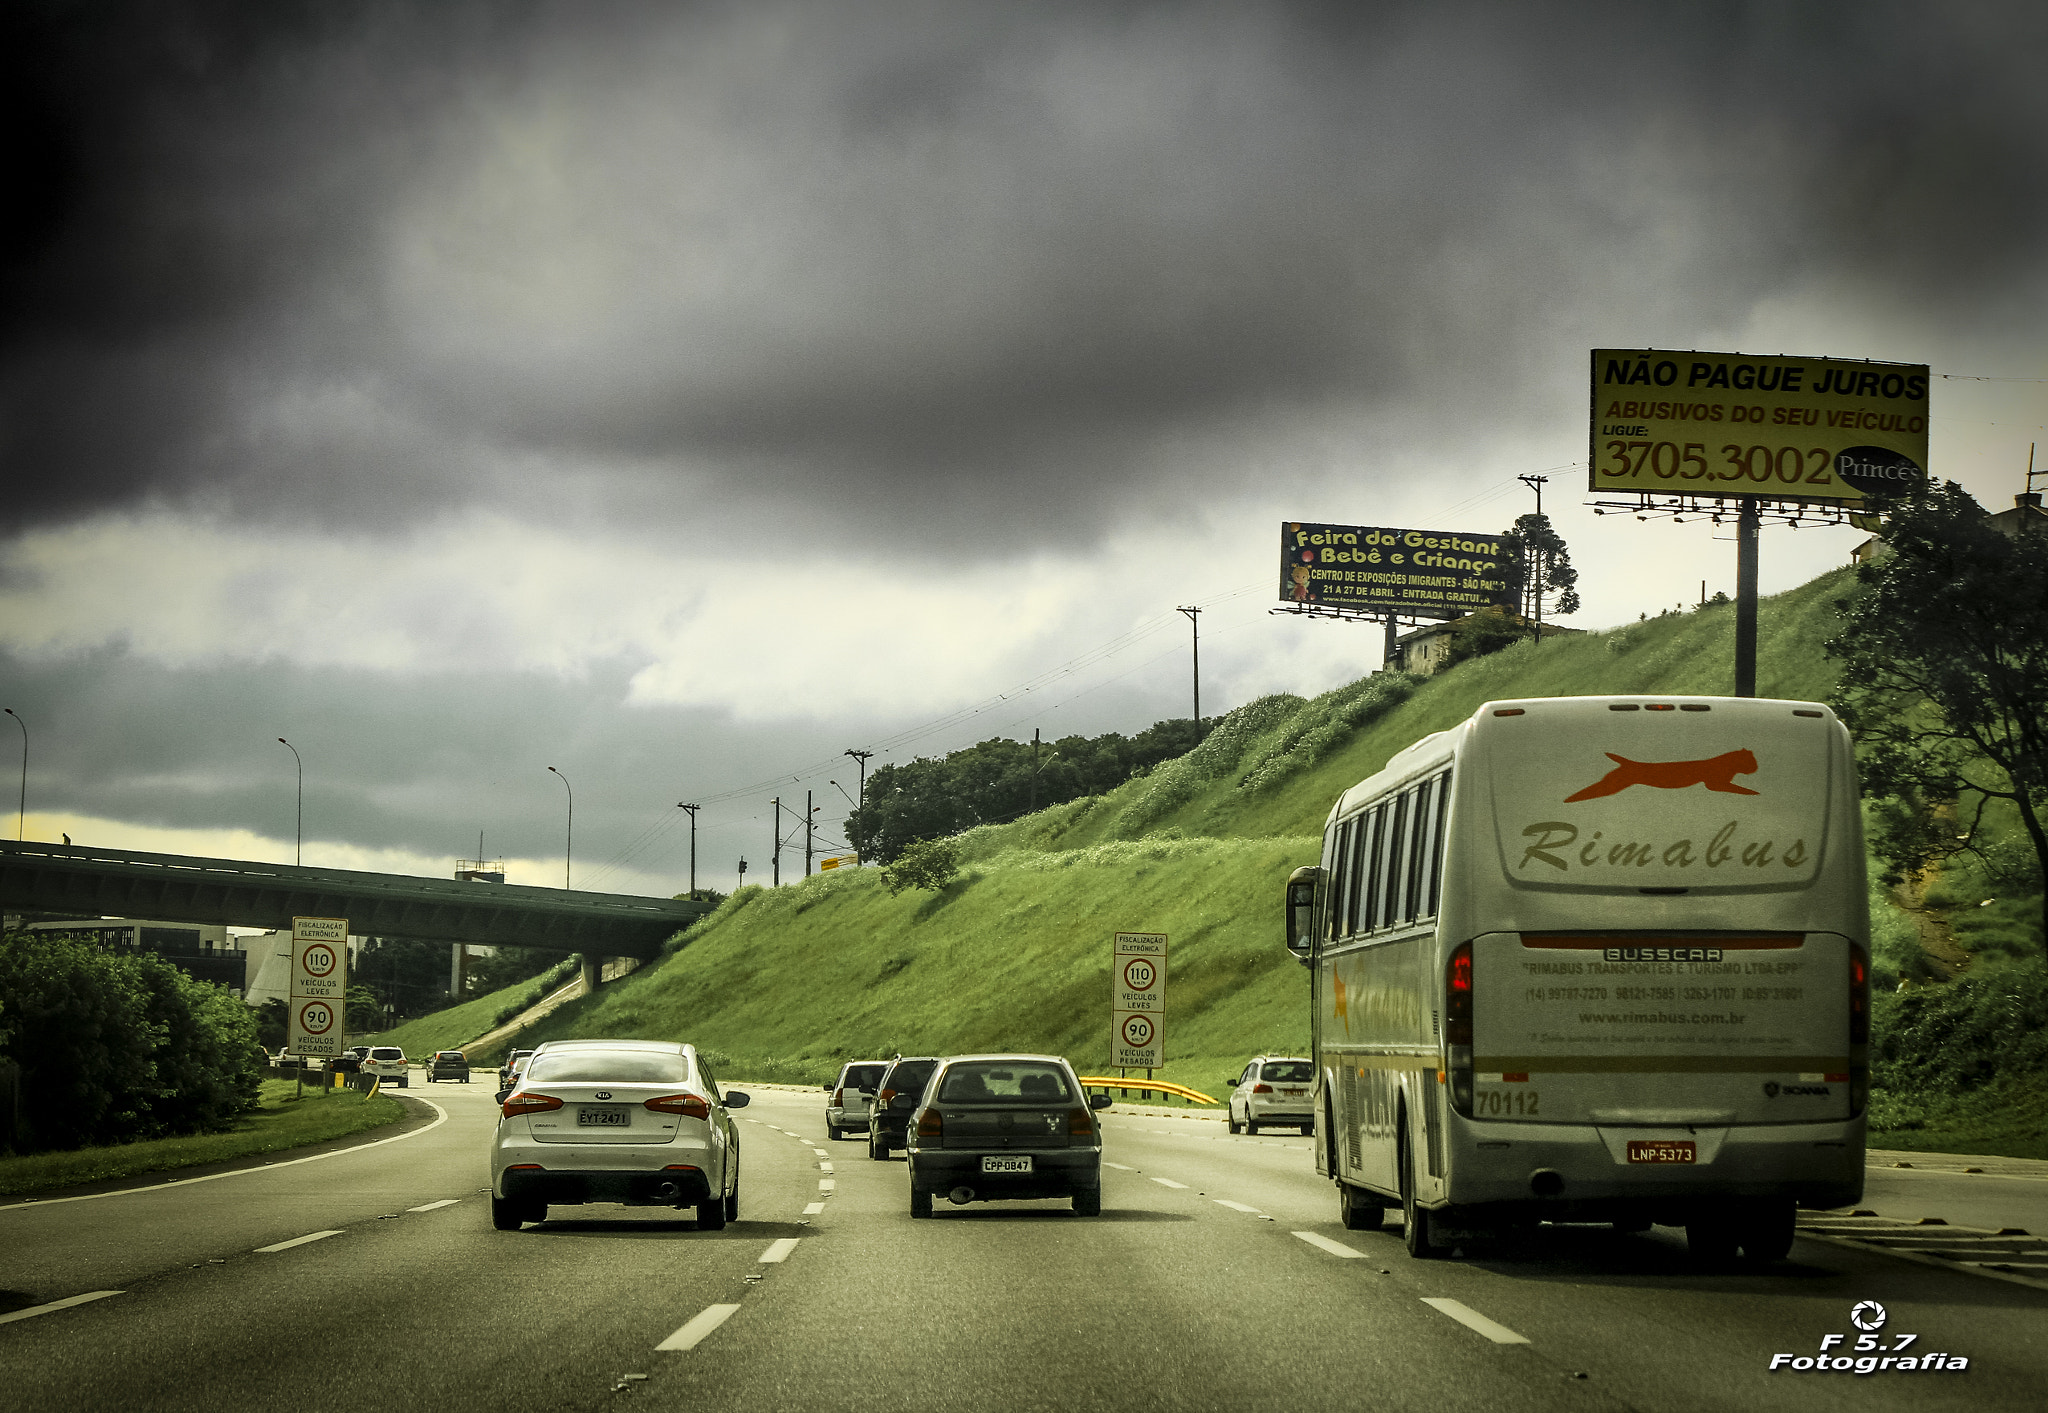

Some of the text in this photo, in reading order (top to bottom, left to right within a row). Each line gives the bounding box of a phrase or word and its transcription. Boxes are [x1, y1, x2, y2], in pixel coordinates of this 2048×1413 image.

[1603, 354, 1927, 400] NÃO PAGUE JUROS
[1605, 400, 1925, 434] ABUSIVOS DO SEU VEÍCULO
[1602, 424, 1649, 437] LIGUE:
[1601, 439, 1832, 485] 3705.3002
[1296, 529, 1501, 556] Feira da Gestant
[1320, 547, 1382, 564] Bebê
[1389, 552, 1405, 565] e
[1311, 568, 1343, 581] CENTRO
[1344, 571, 1356, 582] DE
[1357, 571, 1407, 586] EXPOSIÇÕES
[1408, 574, 1457, 588] IMIGRANTES
[1462, 576, 1479, 590] SÃO
[1322, 584, 1333, 594] 21
[1335, 585, 1342, 594] A
[1343, 585, 1355, 595] 27
[1356, 586, 1368, 596] DE
[1369, 587, 1396, 598] ABRIL
[1402, 588, 1444, 600] ENTRADA
[1518, 820, 1810, 872] Rimabus
[297, 921, 343, 930] FISCALIZAÇÃO
[300, 930, 340, 938] ELETRÔNICA
[1119, 936, 1163, 944] FISCALIZAÇÃO
[1121, 944, 1160, 952] ELETRÔNICA
[1606, 948, 1721, 961] BUSSCAR
[309, 953, 329, 967] 110
[1130, 967, 1150, 981] 110
[1586, 962, 1673, 975] TRANSPORTES
[1676, 962, 1684, 975] E
[1688, 962, 1741, 975] TURISMO
[300, 978, 337, 988] VEÍCULOS
[1121, 991, 1157, 1001] VEÍCULOS
[307, 1011, 327, 1024] 90
[1579, 1011, 1745, 1024] www.rimabus.com.br
[1129, 1024, 1148, 1037] 90
[297, 1035, 334, 1045] VEÍCULOS
[297, 1045, 334, 1053] PESADOS
[1119, 1047, 1155, 1057] VEÍCULOS
[1119, 1057, 1154, 1066] PESADOS
[1476, 1091, 1539, 1115] 70112
[579, 1113, 626, 1124] EYT-2471
[1631, 1148, 1692, 1161] LNP-5373
[984, 1161, 1029, 1171] CPP-0847
